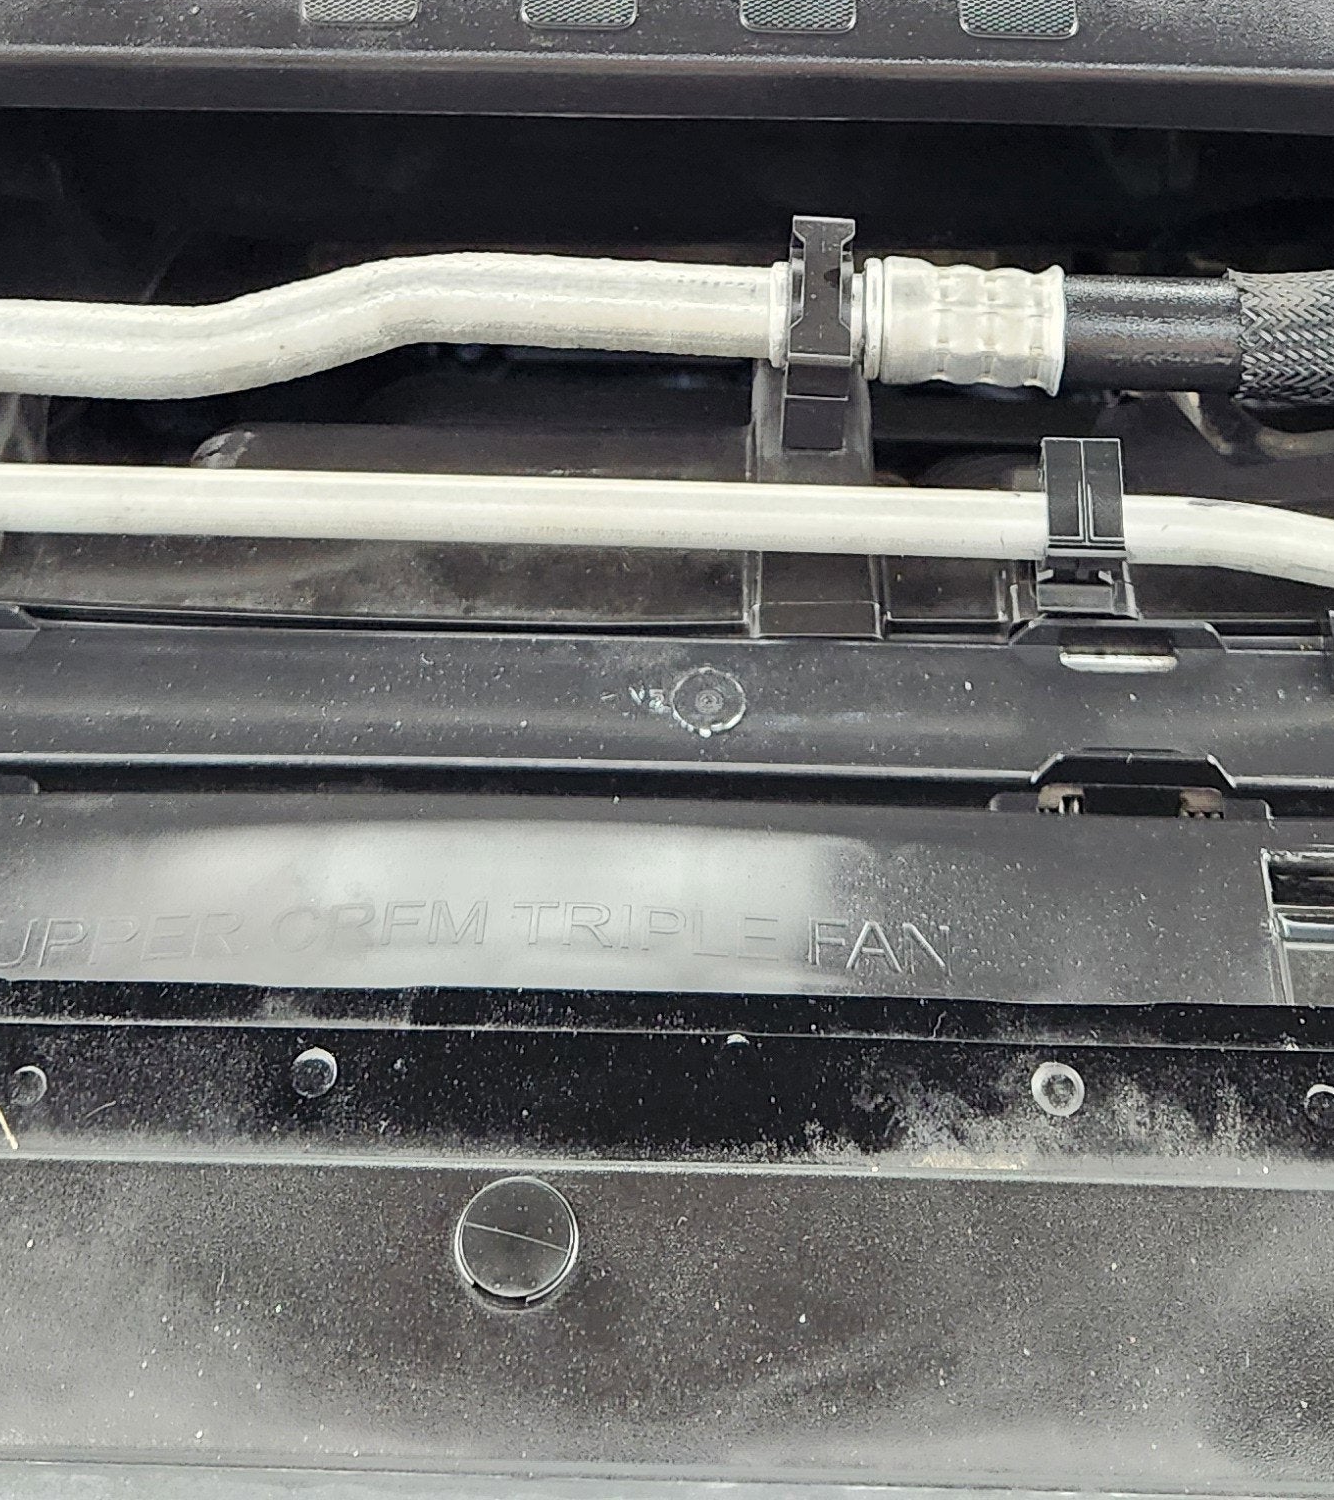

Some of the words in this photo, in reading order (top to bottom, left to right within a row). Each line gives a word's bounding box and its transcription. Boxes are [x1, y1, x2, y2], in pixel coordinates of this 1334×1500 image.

[269, 900, 489, 954] CRFM
[513, 900, 780, 962] TRIPLE
[807, 915, 954, 978] FAN
